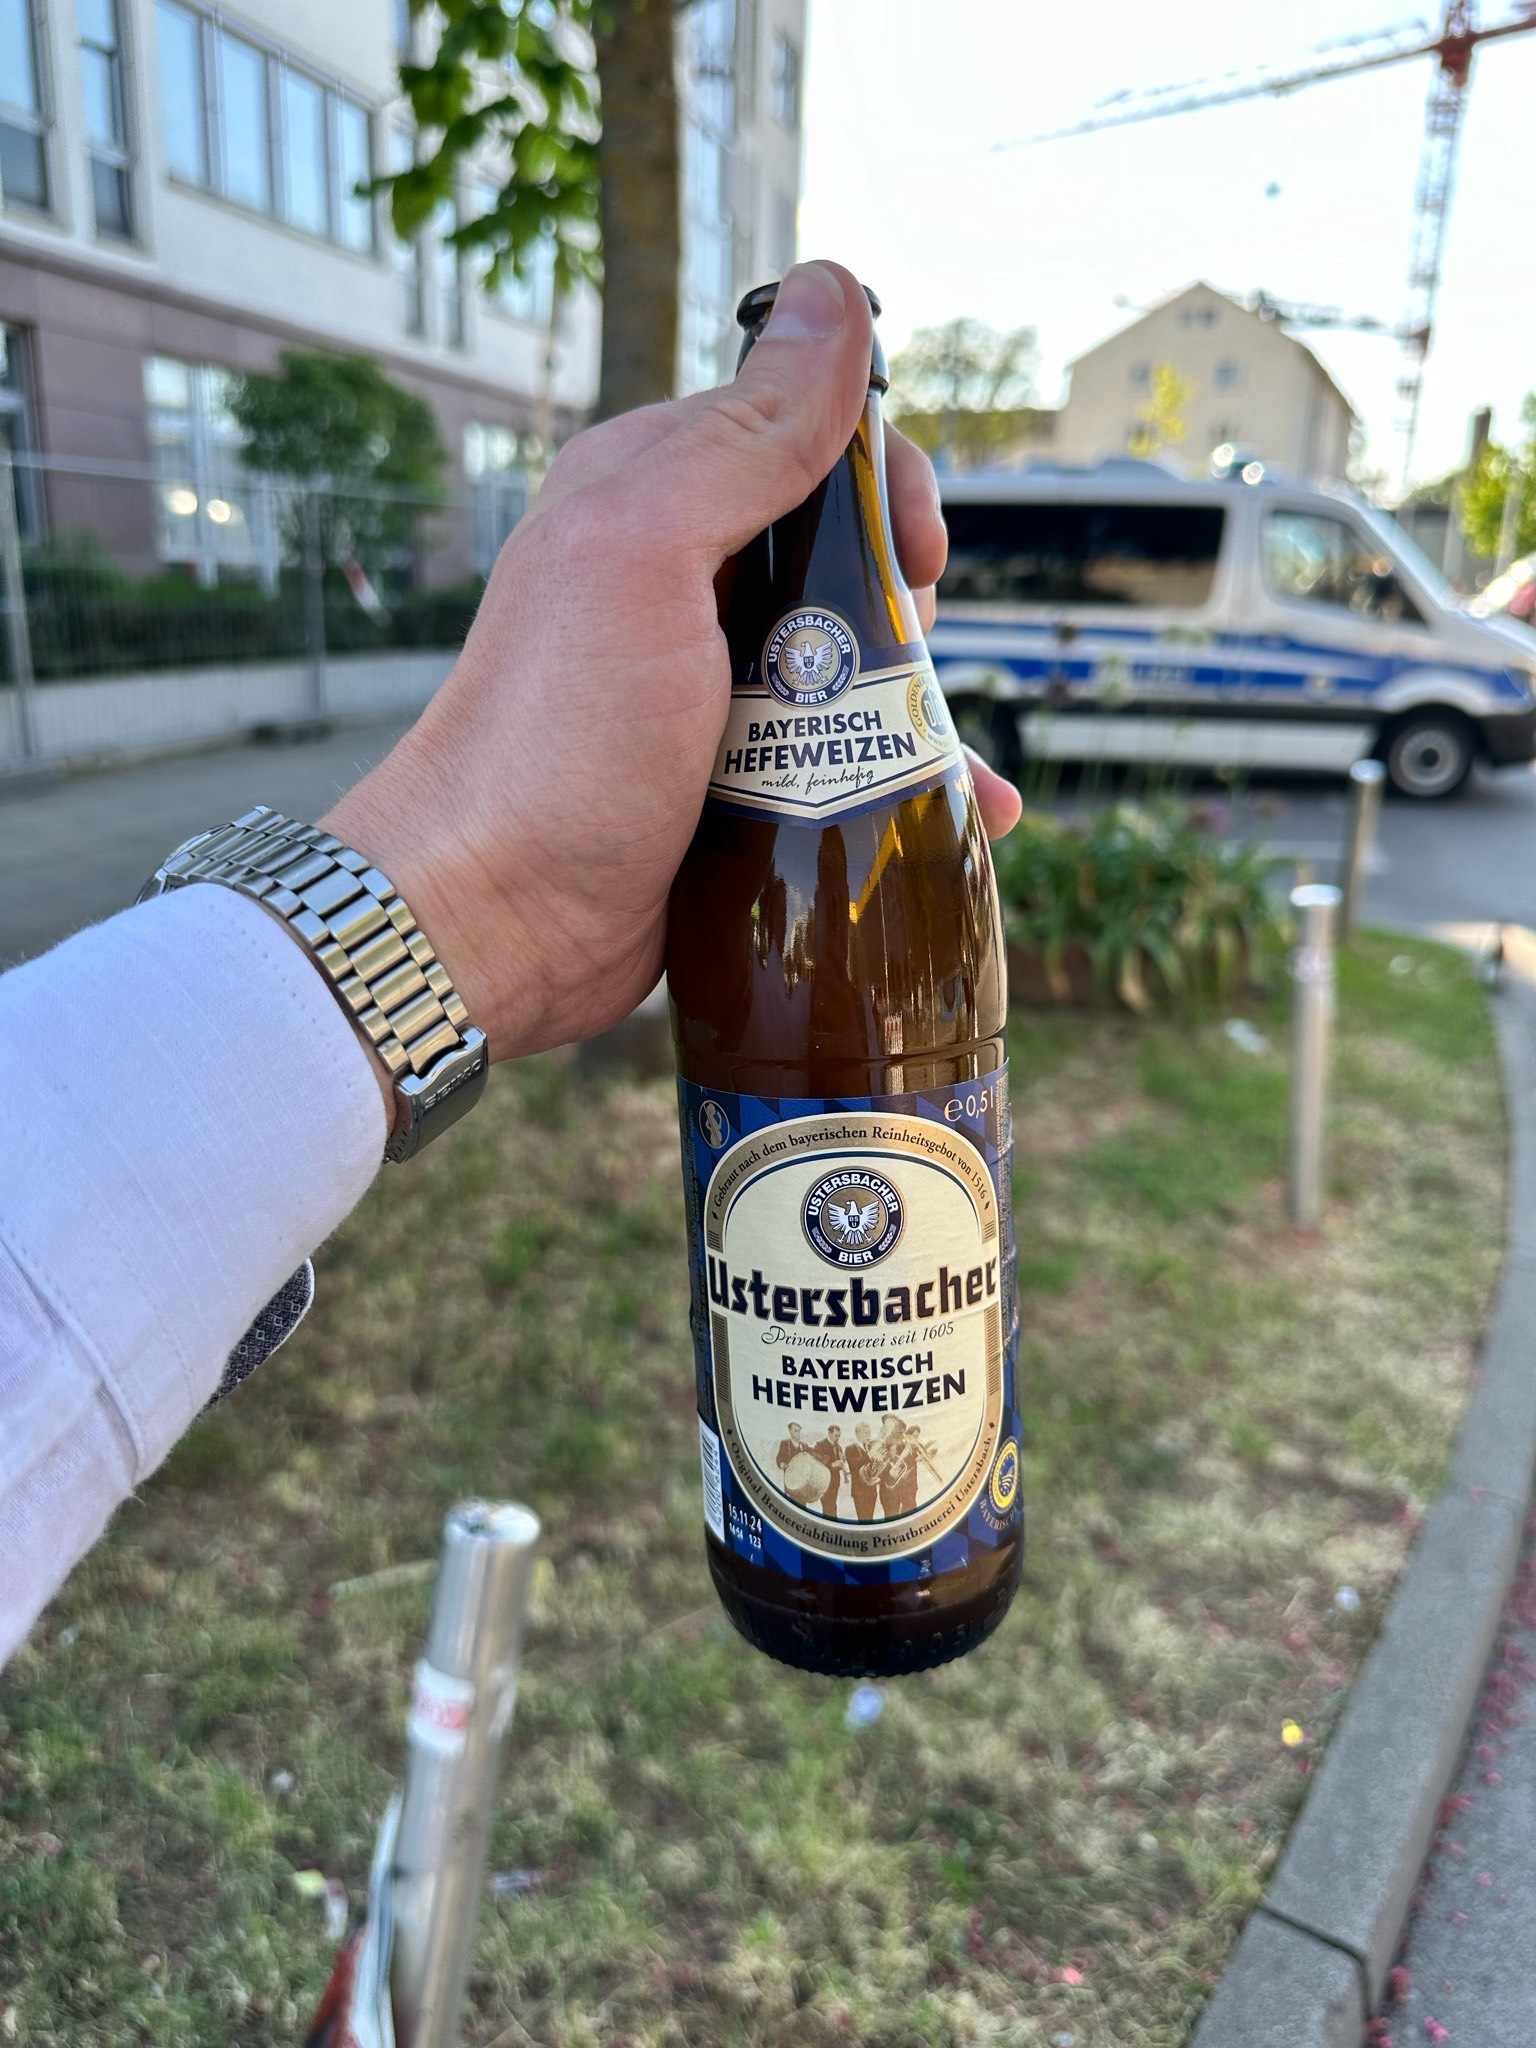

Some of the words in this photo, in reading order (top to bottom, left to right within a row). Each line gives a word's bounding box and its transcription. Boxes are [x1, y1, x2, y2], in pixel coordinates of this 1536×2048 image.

[768, 615, 851, 663] USTERSBACHER
[794, 690, 828, 703] BIER
[747, 710, 883, 743] BAYERISCH
[723, 732, 917, 775] HEFEWEIZEN
[761, 773, 800, 789] mild,
[804, 765, 875, 796] feinhefig
[714, 1170, 740, 1207] Gebraut
[738, 1151, 761, 1173] nach
[762, 1143, 788, 1157] dem
[788, 1126, 867, 1147] bayerischen
[872, 1126, 957, 1161] Reinheitsgebot
[957, 1156, 972, 1175] von
[971, 1172, 989, 1200] 1516
[808, 1173, 899, 1216] USTERSBACHER
[838, 1250, 874, 1264] BIER
[707, 1253, 998, 1327] Ustersbacher
[761, 1325, 886, 1349] Privatbrauerei
[890, 1330, 917, 1347] seit
[922, 1321, 955, 1342] 1605
[781, 1351, 934, 1380] BAYERISCH
[752, 1368, 967, 1413] HEFEWEIZEN
[731, 1441, 762, 1494] Original
[761, 1493, 869, 1552] Brauereiabfüllung
[872, 1501, 957, 1549] Privatbrauerei
[955, 1436, 992, 1503] Ustersbach
[728, 1503, 763, 1533] 15.11.24
